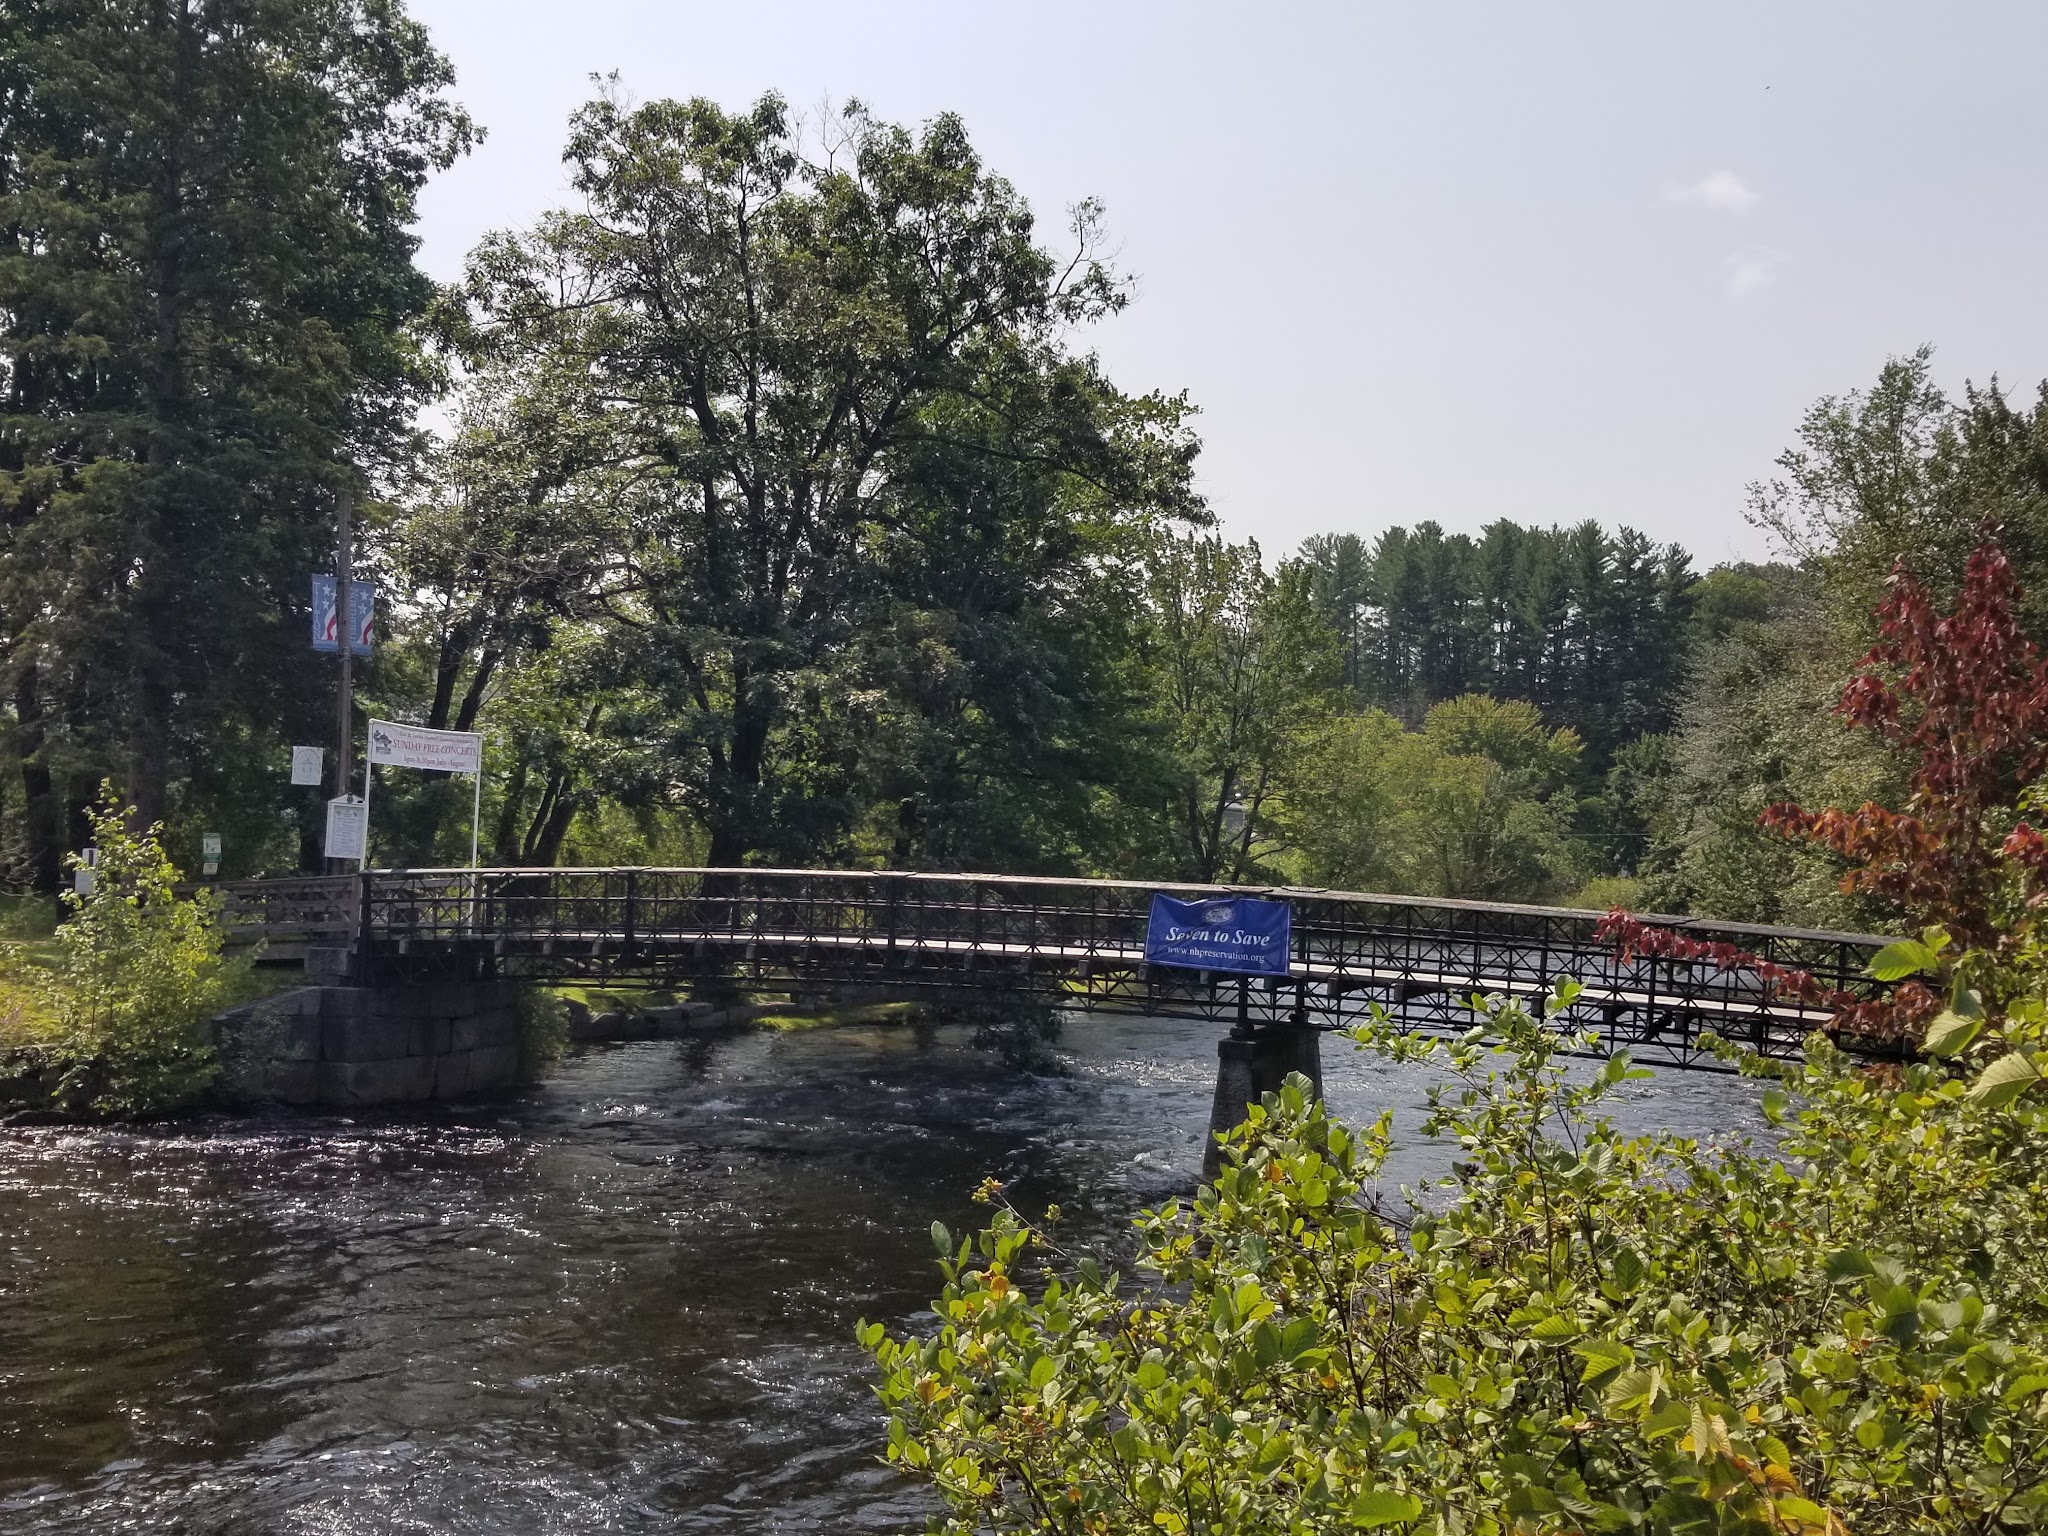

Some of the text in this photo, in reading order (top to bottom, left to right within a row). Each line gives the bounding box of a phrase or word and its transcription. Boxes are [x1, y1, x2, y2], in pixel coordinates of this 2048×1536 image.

[313, 582, 321, 640] TILTON
[350, 587, 359, 643] NORTHFIELD
[393, 739, 477, 756] SUNDAY FREE CONCERTS
[1166, 926, 1270, 946] Seven to Save
[1167, 946, 1265, 963] www.nhpreservation.org
